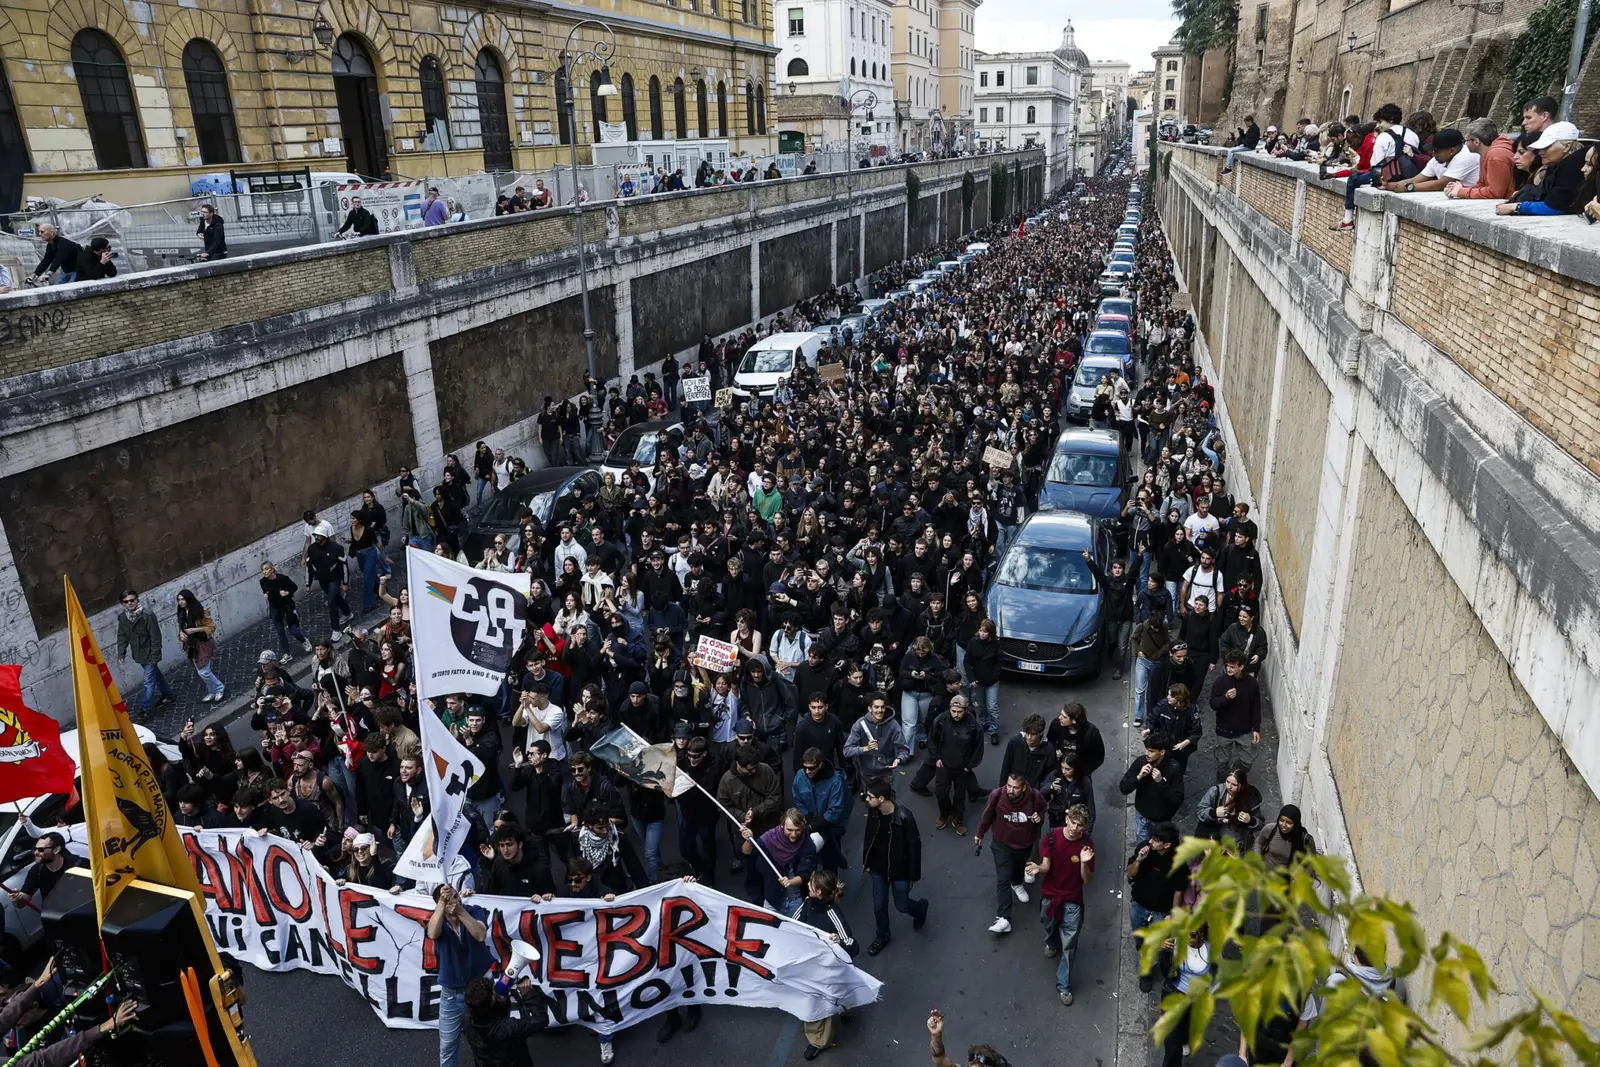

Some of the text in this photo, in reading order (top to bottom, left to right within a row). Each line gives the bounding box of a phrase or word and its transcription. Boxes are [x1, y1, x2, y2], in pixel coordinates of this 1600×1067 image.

[437, 669, 451, 677] TORTO
[491, 674, 499, 682] UN
[183, 832, 782, 989] AMO LE TNEBRE
